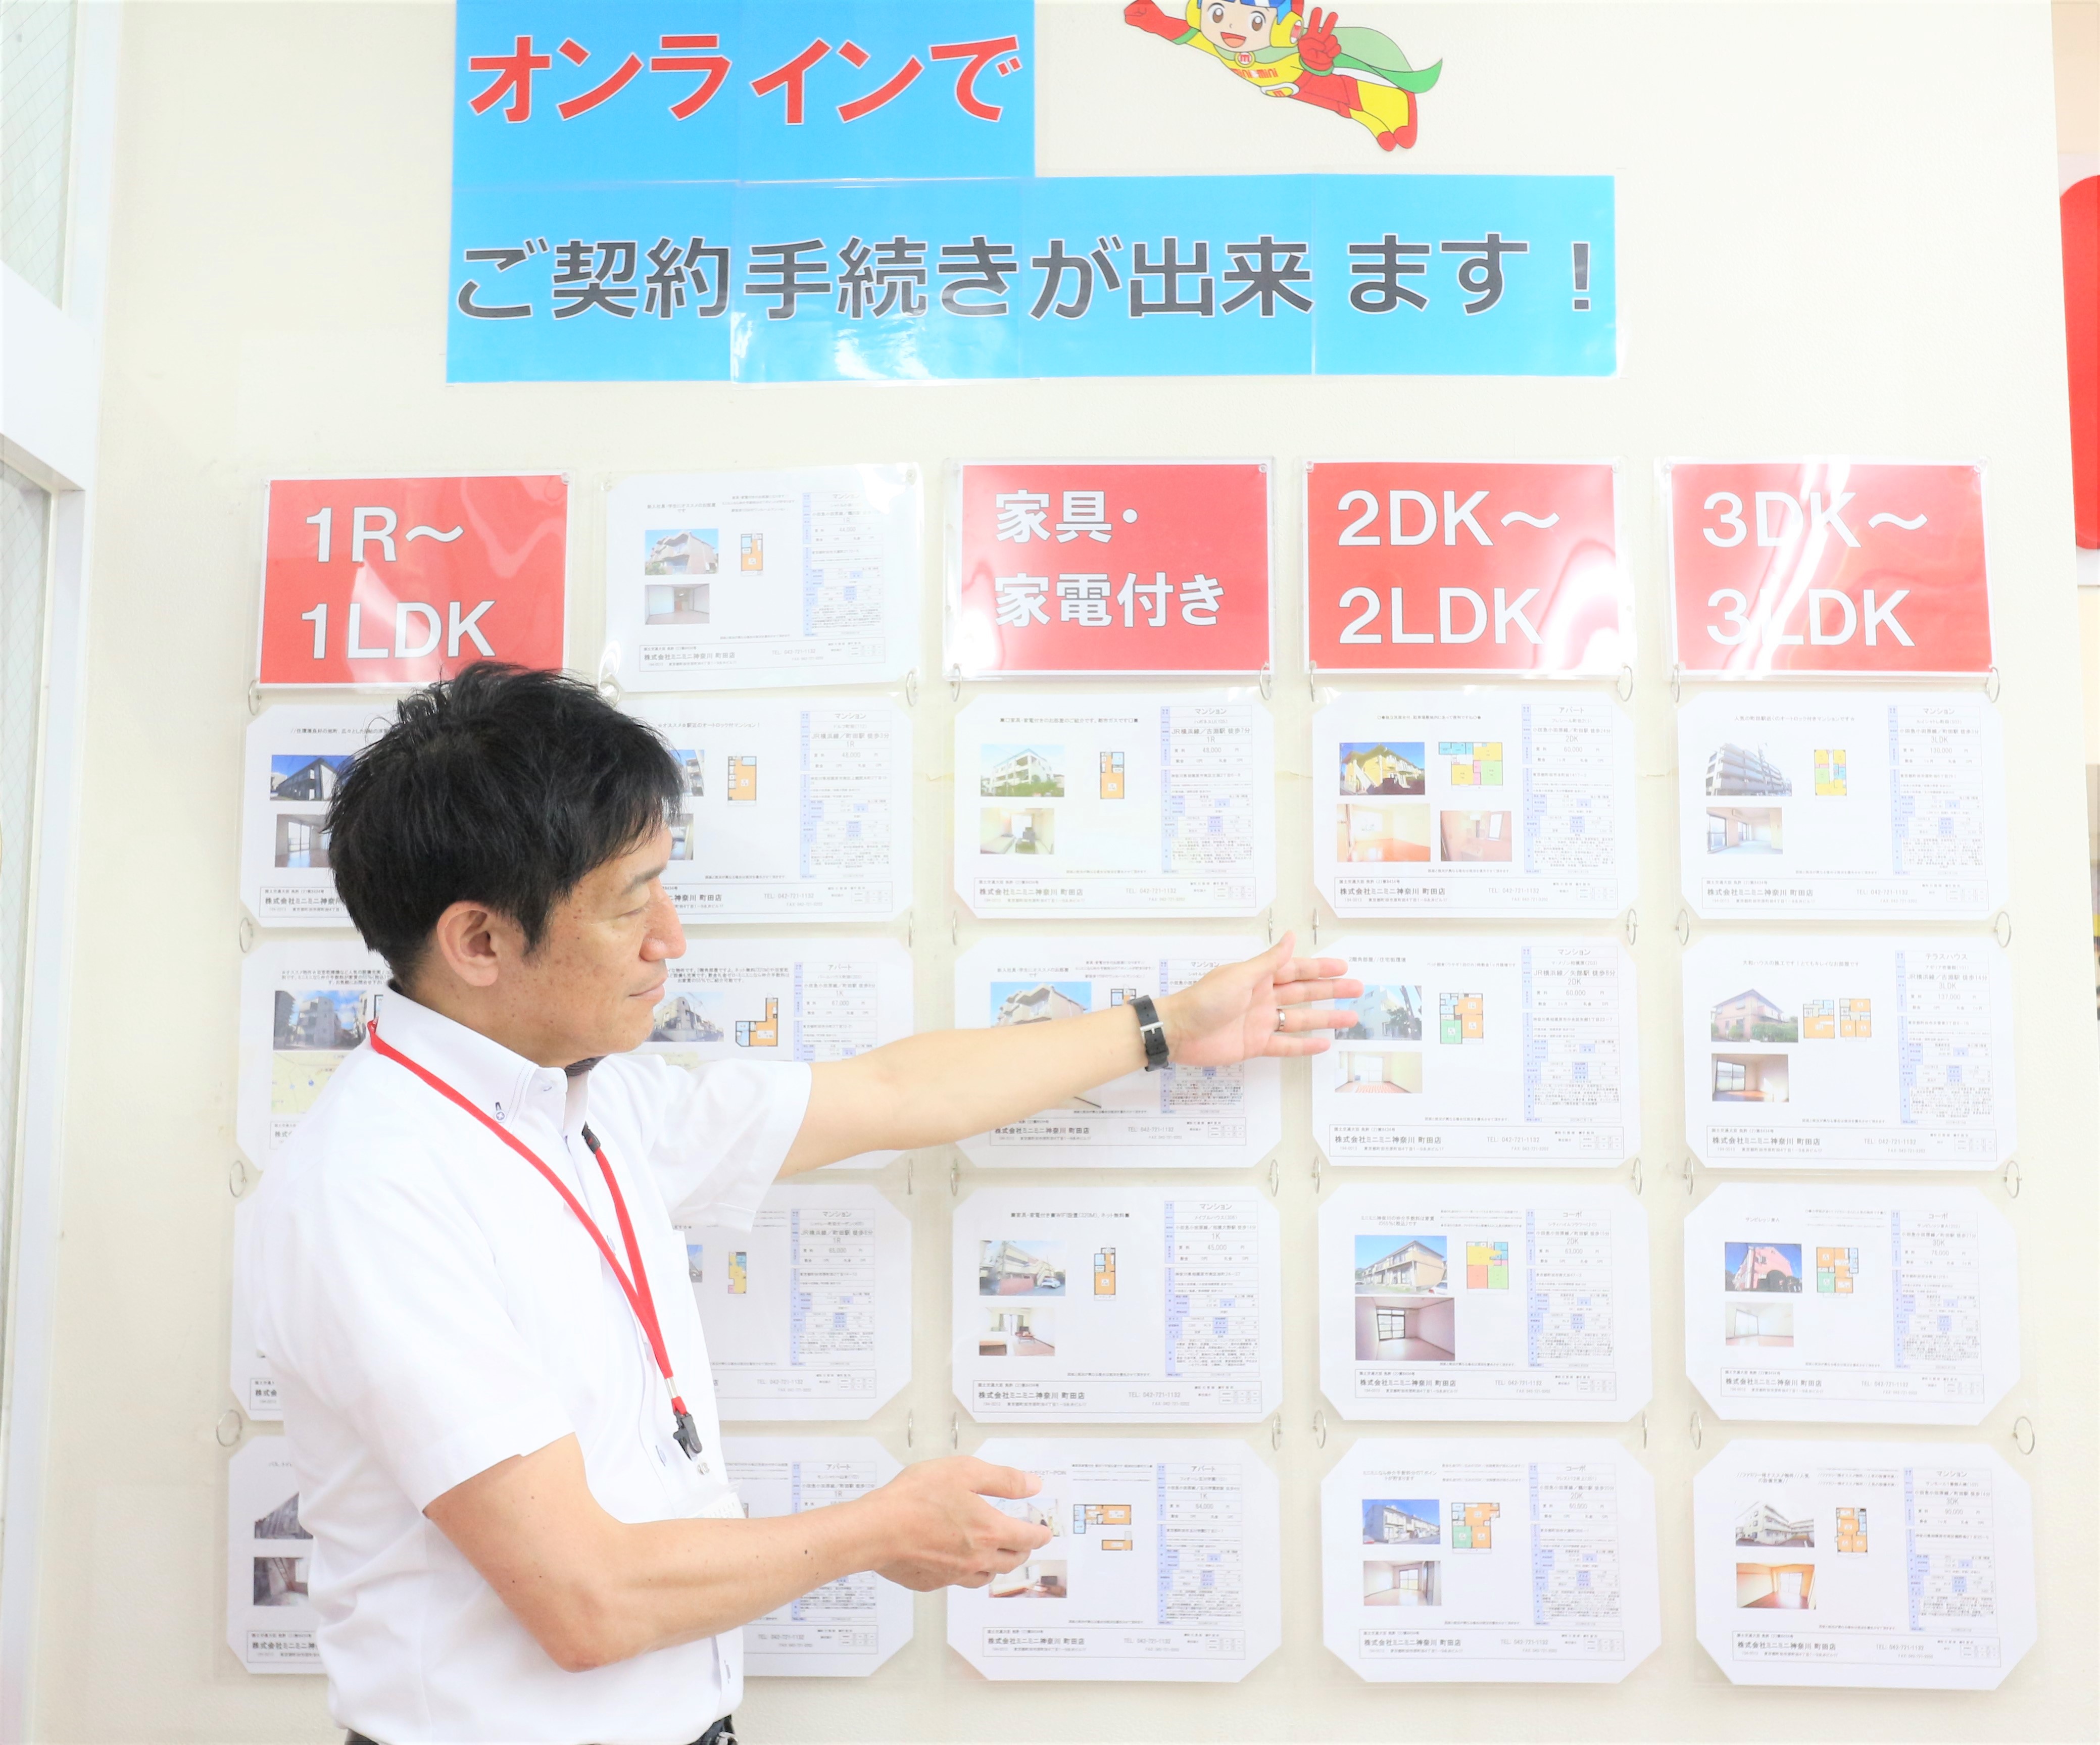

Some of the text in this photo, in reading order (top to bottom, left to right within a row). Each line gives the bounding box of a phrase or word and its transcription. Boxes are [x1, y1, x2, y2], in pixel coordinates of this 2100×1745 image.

[468, 34, 1022, 125] オンラインで
[994, 571, 1225, 628] 家電付き
[1338, 586, 1544, 645] 2LDK
[301, 600, 497, 660] 1LDK
[1706, 588, 1916, 647] 3LDK
[1340, 887, 1419, 895] 株式会社ミニミニ神奈川
[1707, 888, 1786, 896] 株式会社ミニミニ神奈川
[1335, 1135, 1415, 1143] 株式会社ミニミニ神奈川
[1712, 1137, 1793, 1145] 株式会社ミニミニ神奈川
[1800, 1379, 1822, 1387] 町田店
